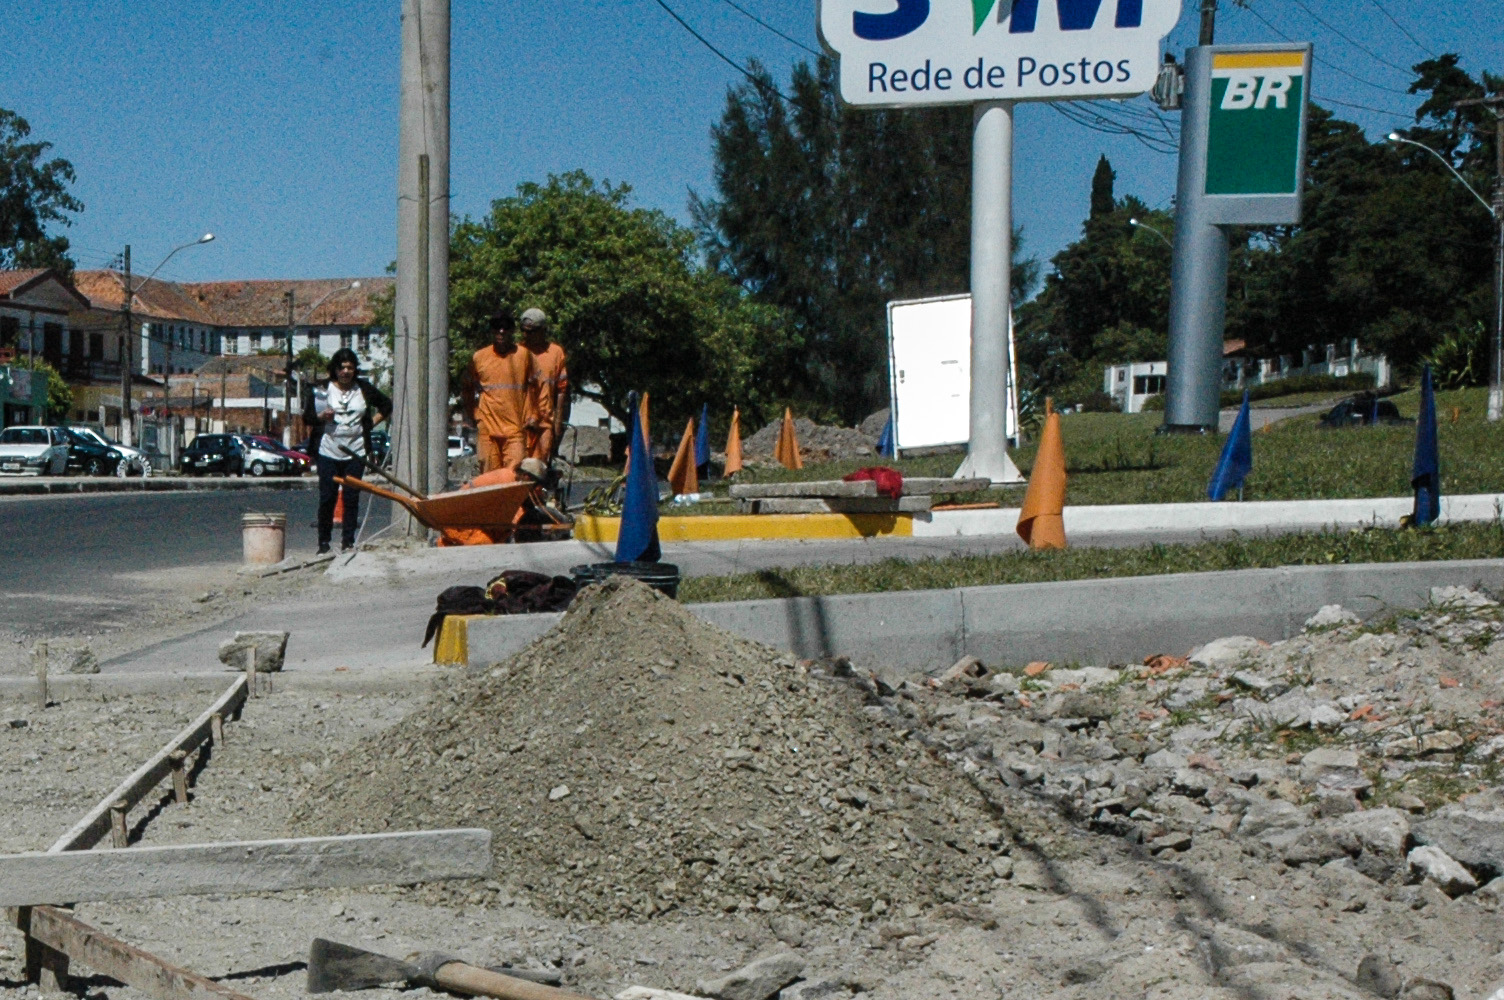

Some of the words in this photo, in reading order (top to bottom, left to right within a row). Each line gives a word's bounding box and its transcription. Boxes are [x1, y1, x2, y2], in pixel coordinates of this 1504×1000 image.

[868, 59, 953, 93] Rede
[963, 57, 1006, 90] de
[1017, 56, 1131, 87] Postos
[1220, 73, 1293, 110] BR
